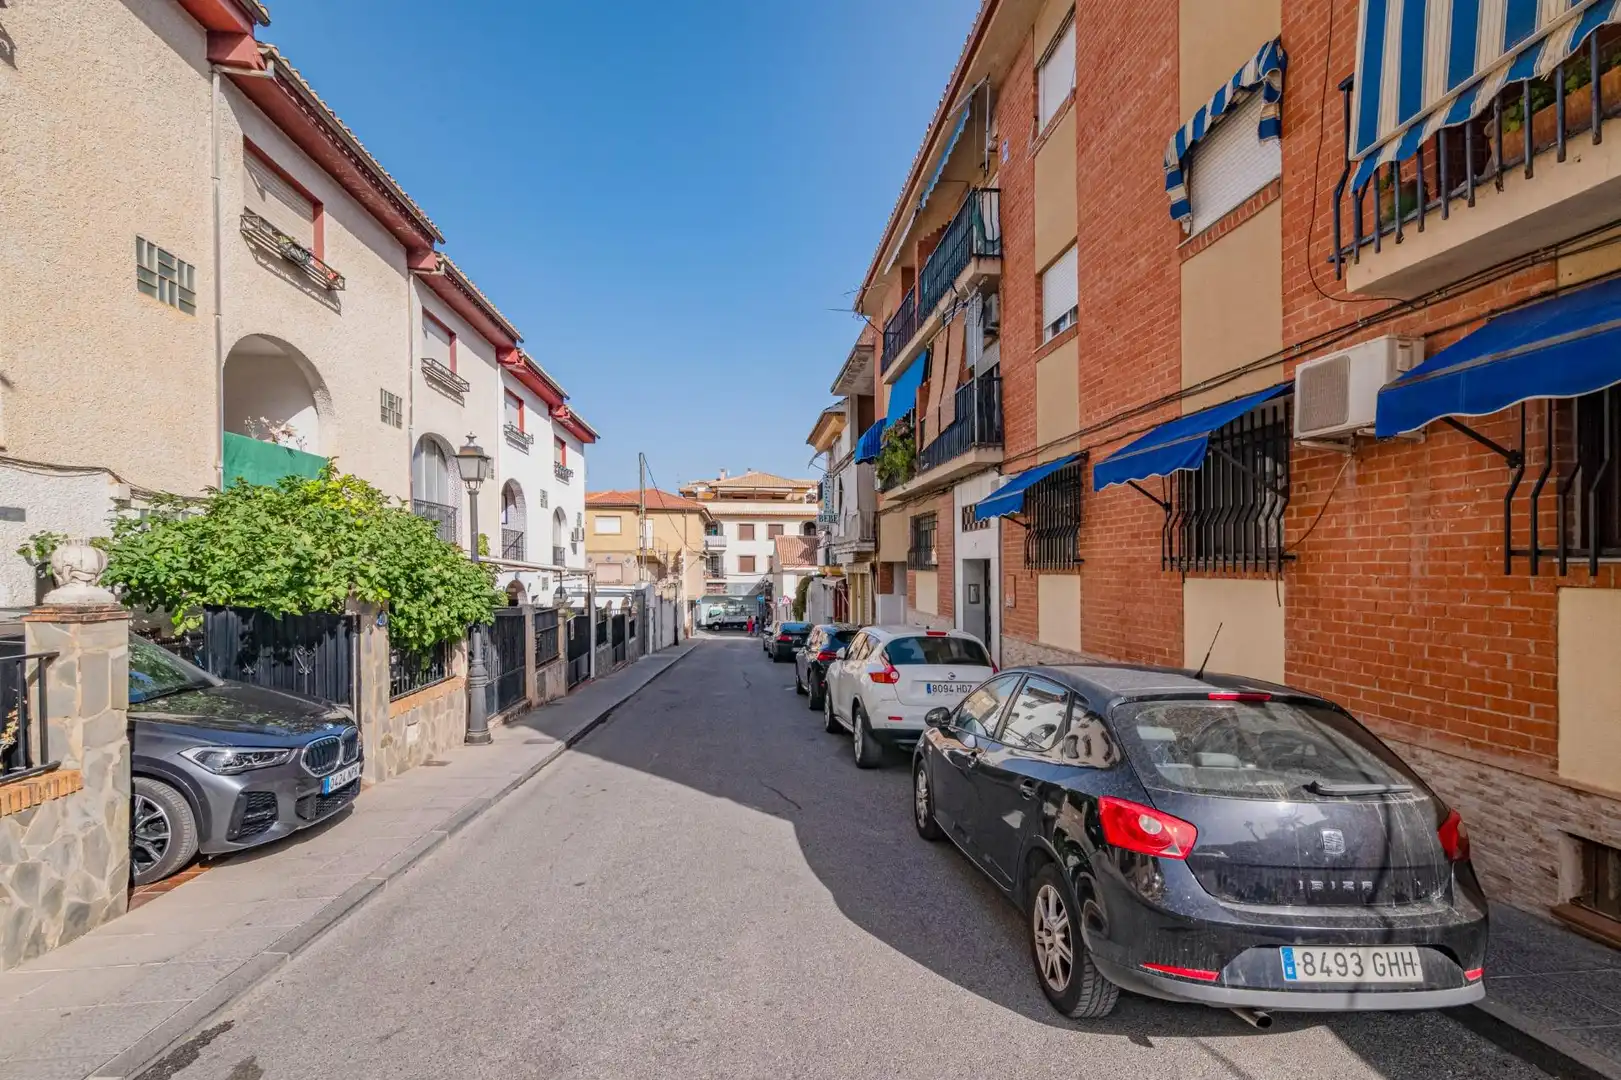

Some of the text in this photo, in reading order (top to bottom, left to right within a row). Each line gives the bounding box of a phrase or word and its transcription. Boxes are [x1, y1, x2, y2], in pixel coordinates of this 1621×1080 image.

[932, 684, 954, 693] 8094
[1302, 952, 1416, 977] 8493 GHH
